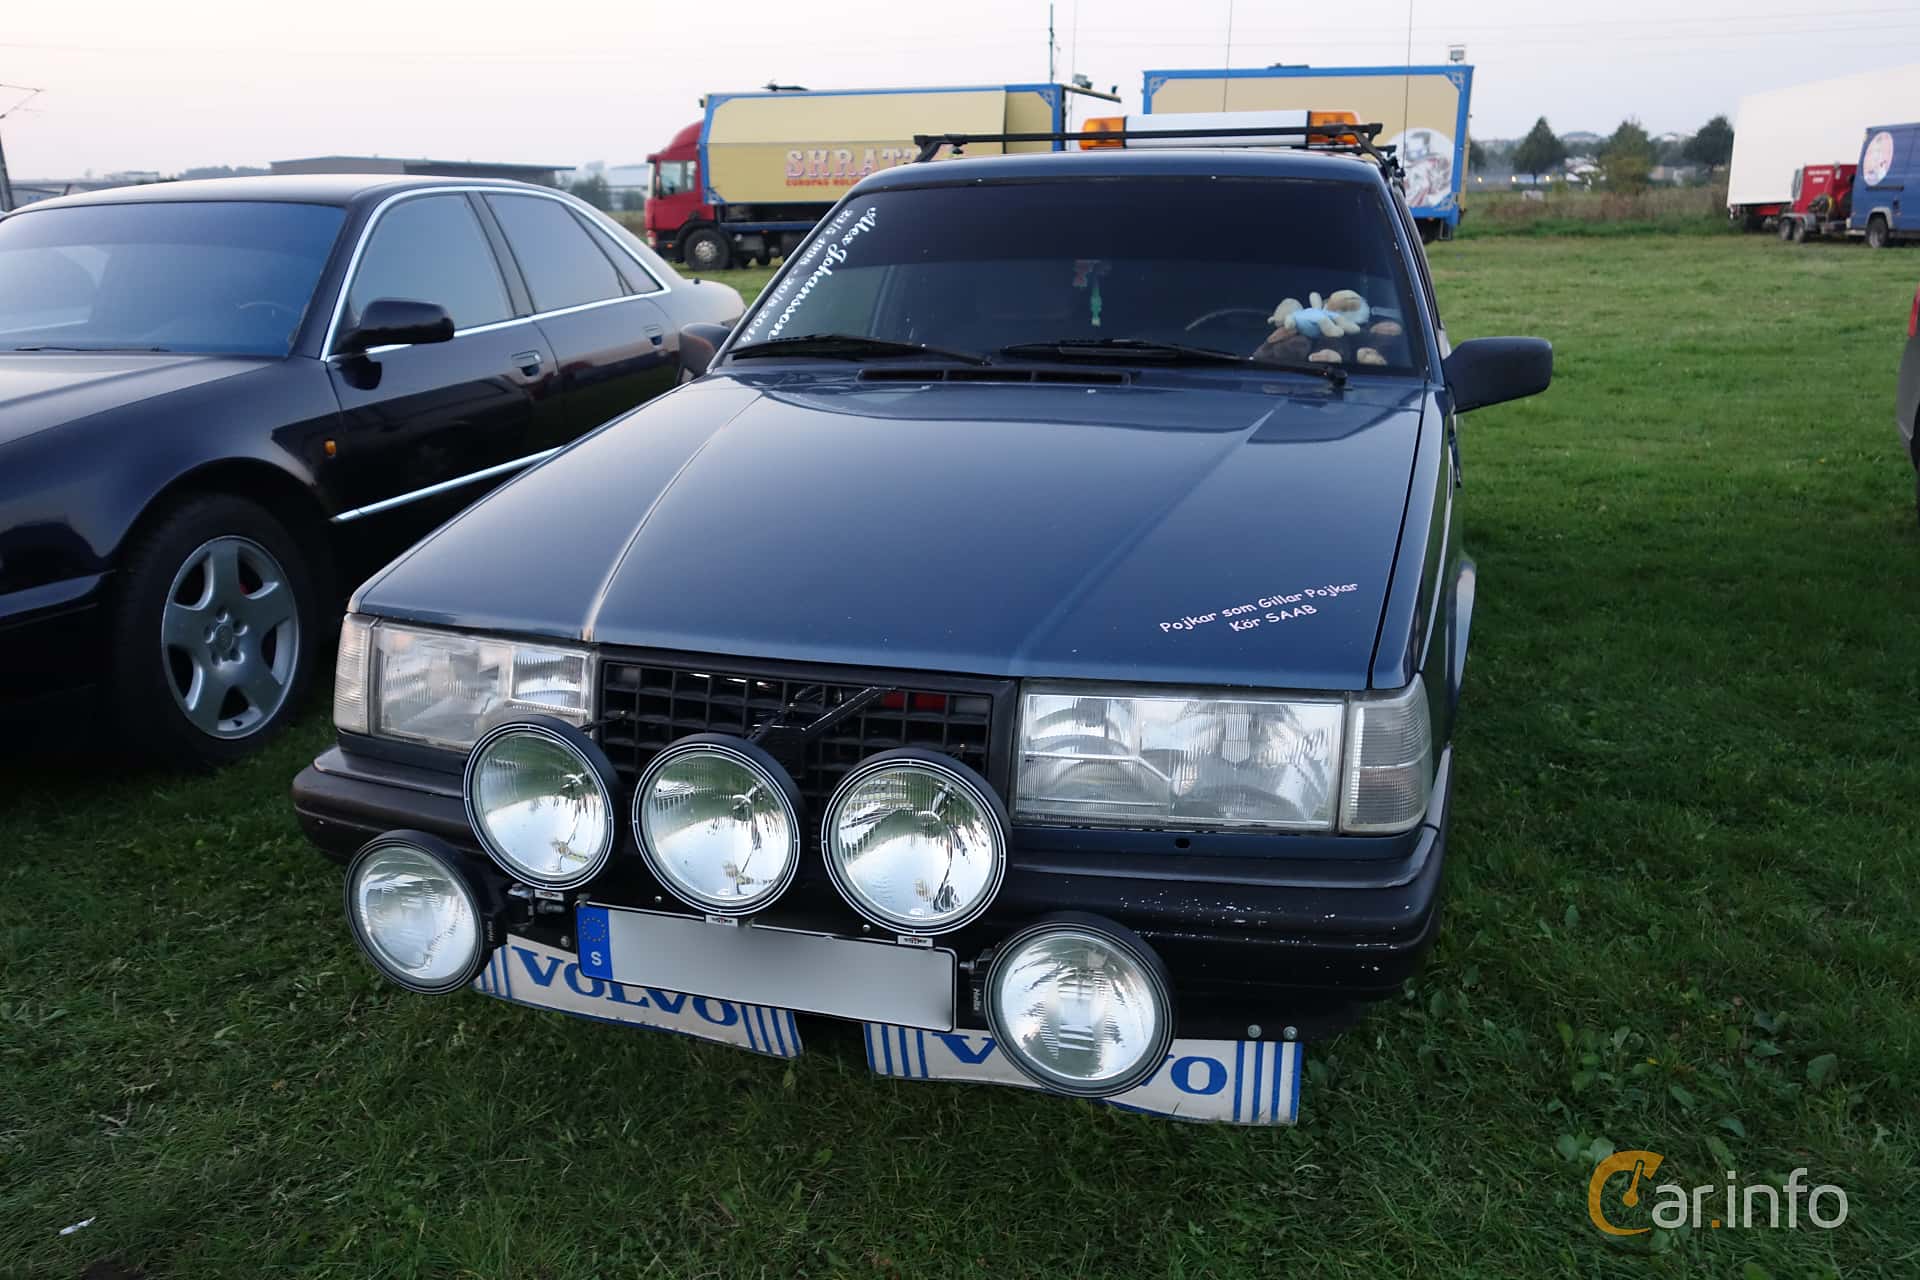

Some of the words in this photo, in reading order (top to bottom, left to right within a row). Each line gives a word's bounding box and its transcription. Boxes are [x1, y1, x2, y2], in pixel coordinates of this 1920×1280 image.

[841, 207, 876, 246] Alex
[767, 243, 847, 341] Johansson
[1159, 611, 1217, 633] Pojkar
[1222, 602, 1258, 618] som
[1258, 592, 1303, 609] Gillar
[1304, 583, 1359, 598] Pojkar
[1229, 617, 1261, 632] Kör
[1265, 604, 1318, 624] SAAB
[591, 952, 602, 966] S
[511, 945, 739, 1027] VOLVO
